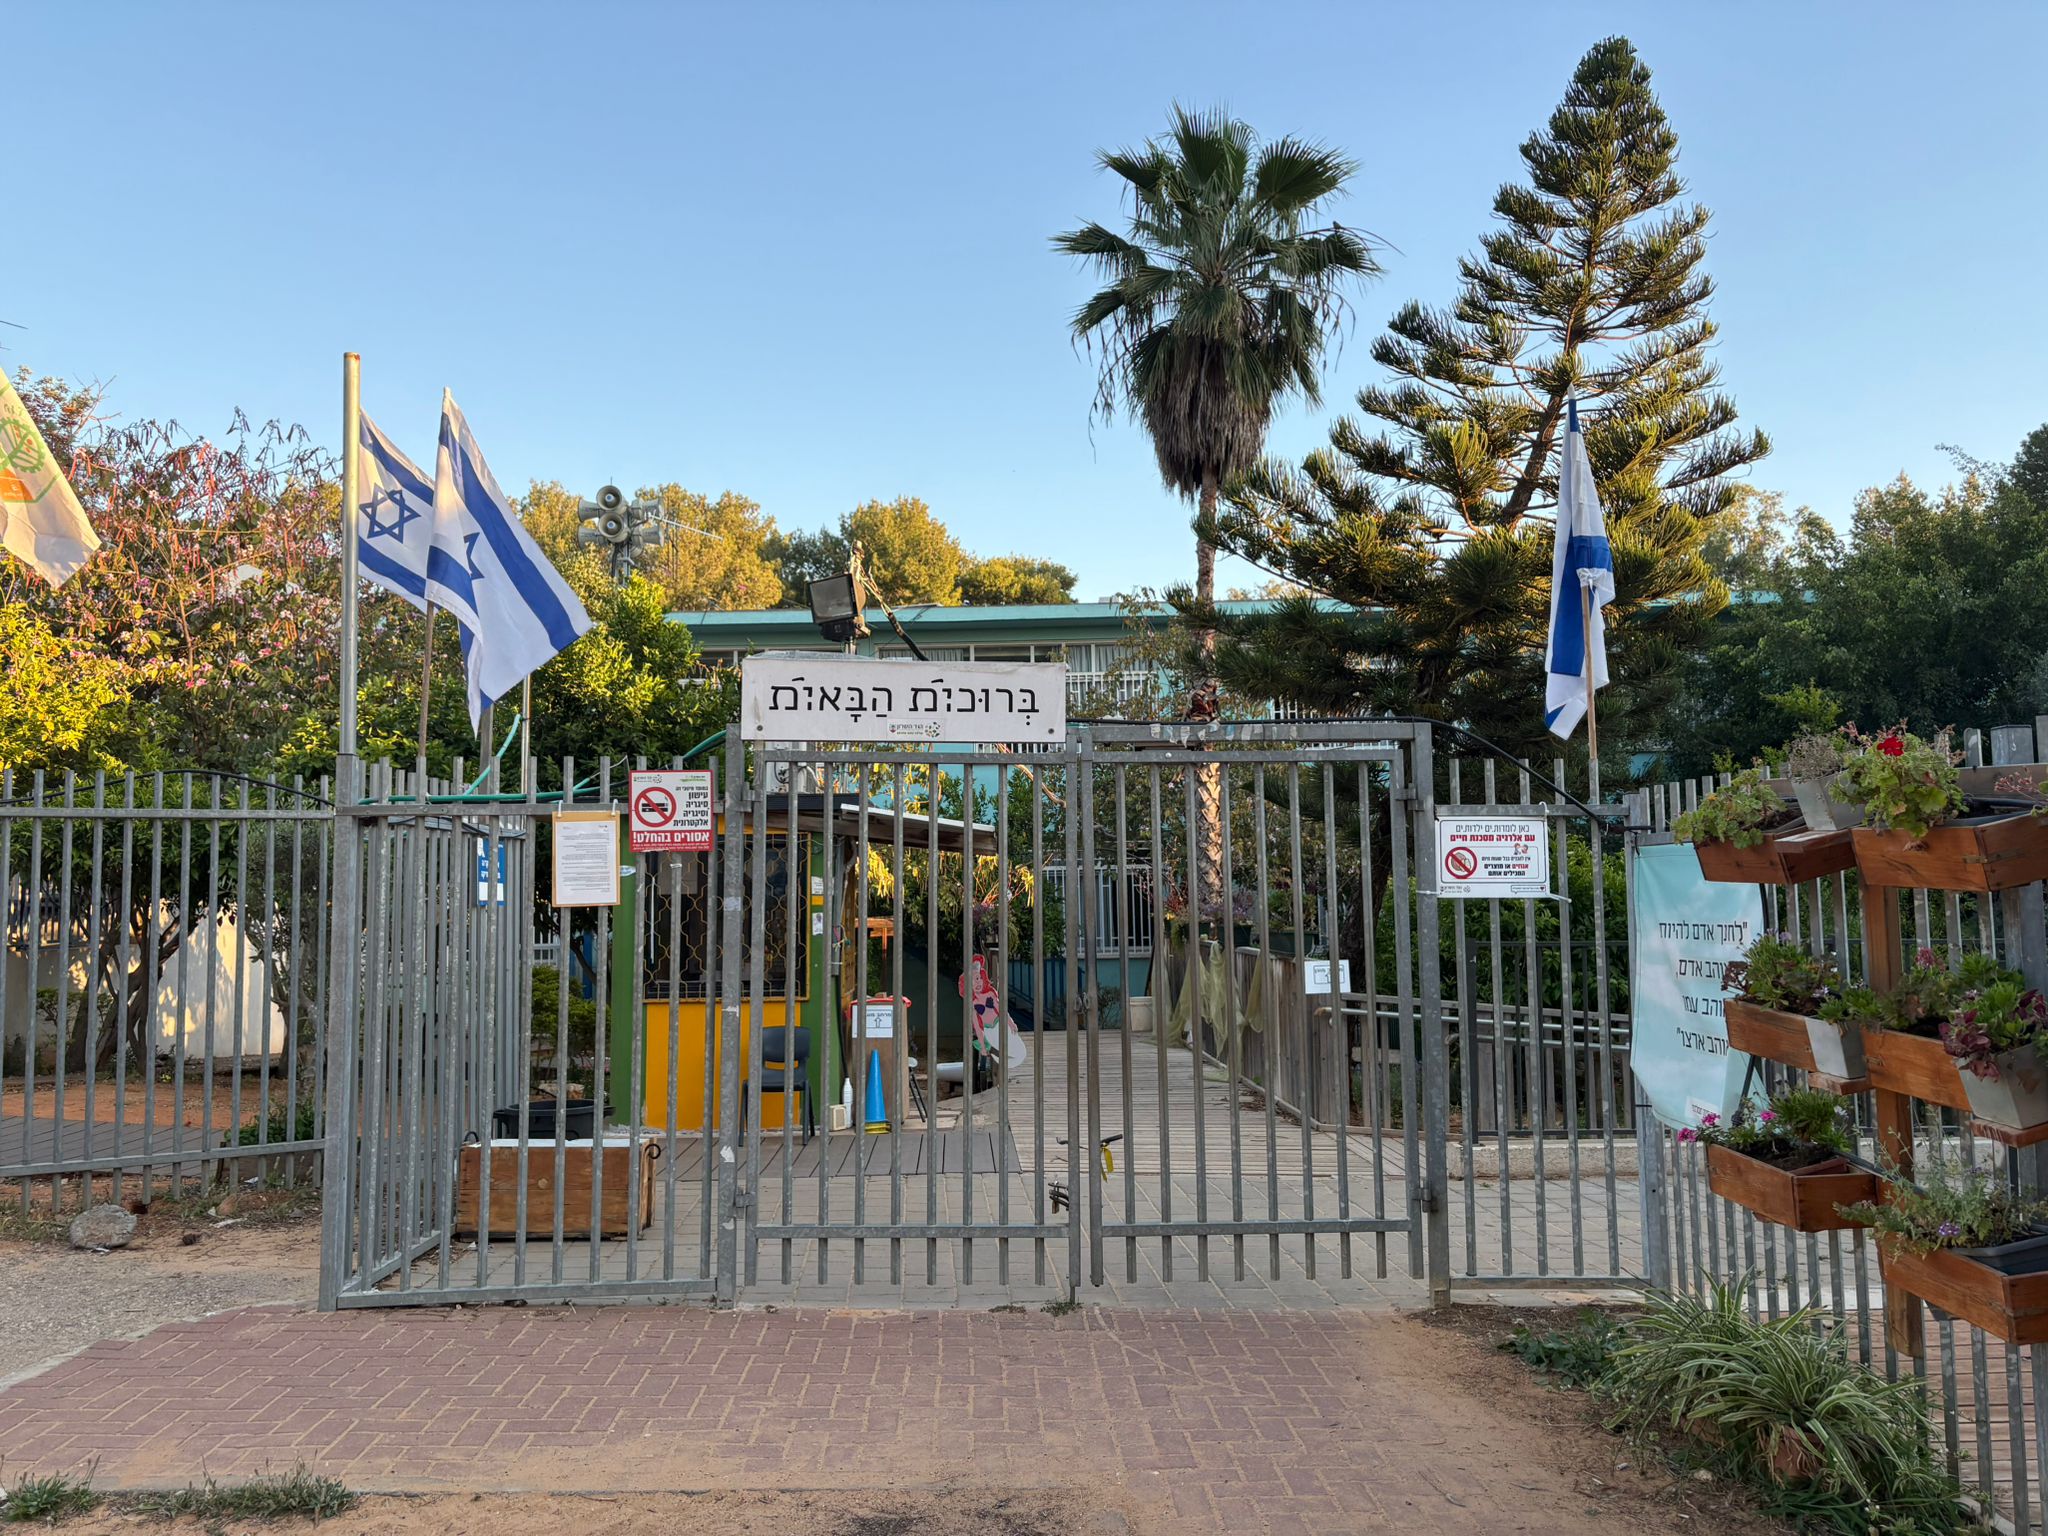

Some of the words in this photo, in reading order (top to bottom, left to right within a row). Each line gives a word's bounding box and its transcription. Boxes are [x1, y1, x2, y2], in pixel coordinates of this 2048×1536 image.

[688, 792, 709, 800] עישון
[686, 800, 709, 808] סיגריה
[683, 809, 709, 817] וסיגריה
[673, 819, 709, 827] אלקטרונית
[1519, 824, 1530, 833] כאן
[633, 831, 672, 843] בהחלט!
[674, 831, 710, 842] אסורים
[1449, 834, 1468, 842] חיים
[1469, 834, 1495, 842] מסכנת
[1496, 833, 1523, 842] אלרגיה
[1524, 834, 1536, 842] עם
[1659, 920, 1690, 940] להיות
[1692, 923, 1715, 941] אדם
[1701, 998, 1726, 1017] והב
